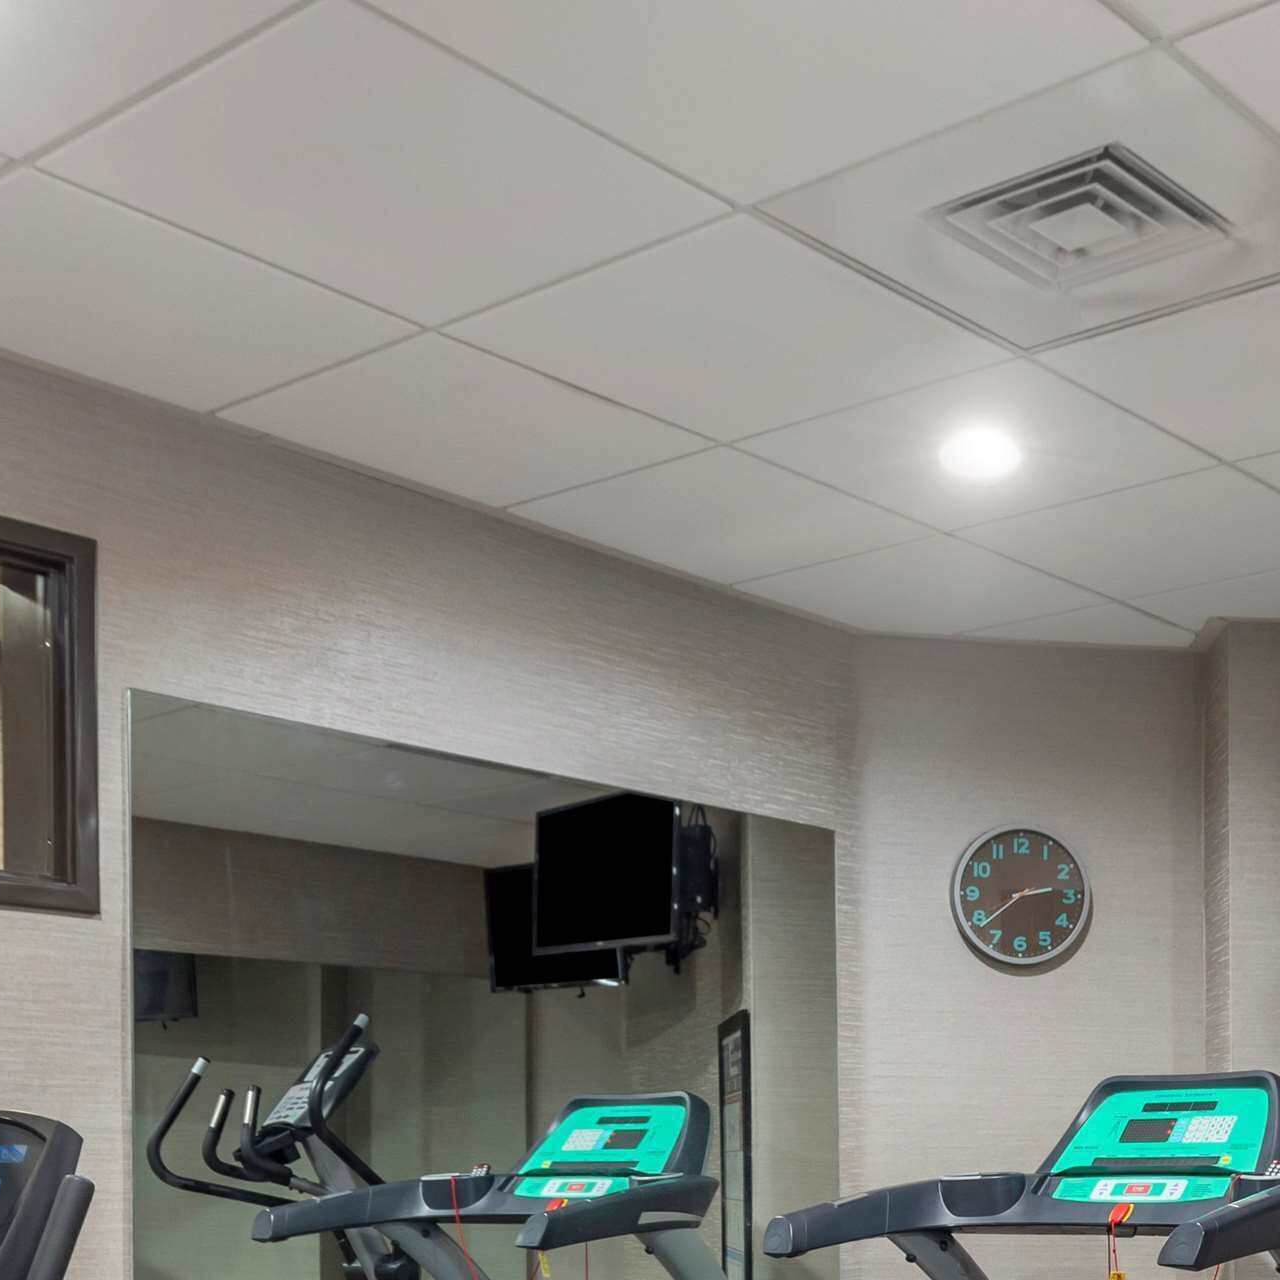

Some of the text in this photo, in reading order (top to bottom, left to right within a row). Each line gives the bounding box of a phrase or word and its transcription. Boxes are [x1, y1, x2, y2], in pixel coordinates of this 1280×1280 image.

[992, 844, 1003, 859] 11
[1013, 838, 1029, 854] 12
[1043, 845, 1048, 860] 1
[973, 862, 990, 877] 10
[1057, 864, 1069, 879] 2
[965, 886, 980, 901] 9
[1062, 889, 1076, 904] 3
[972, 910, 986, 925] 8
[1055, 913, 1068, 927] 4
[990, 930, 1002, 944] 7
[1013, 936, 1027, 951] 6
[1039, 931, 1051, 945] 5
